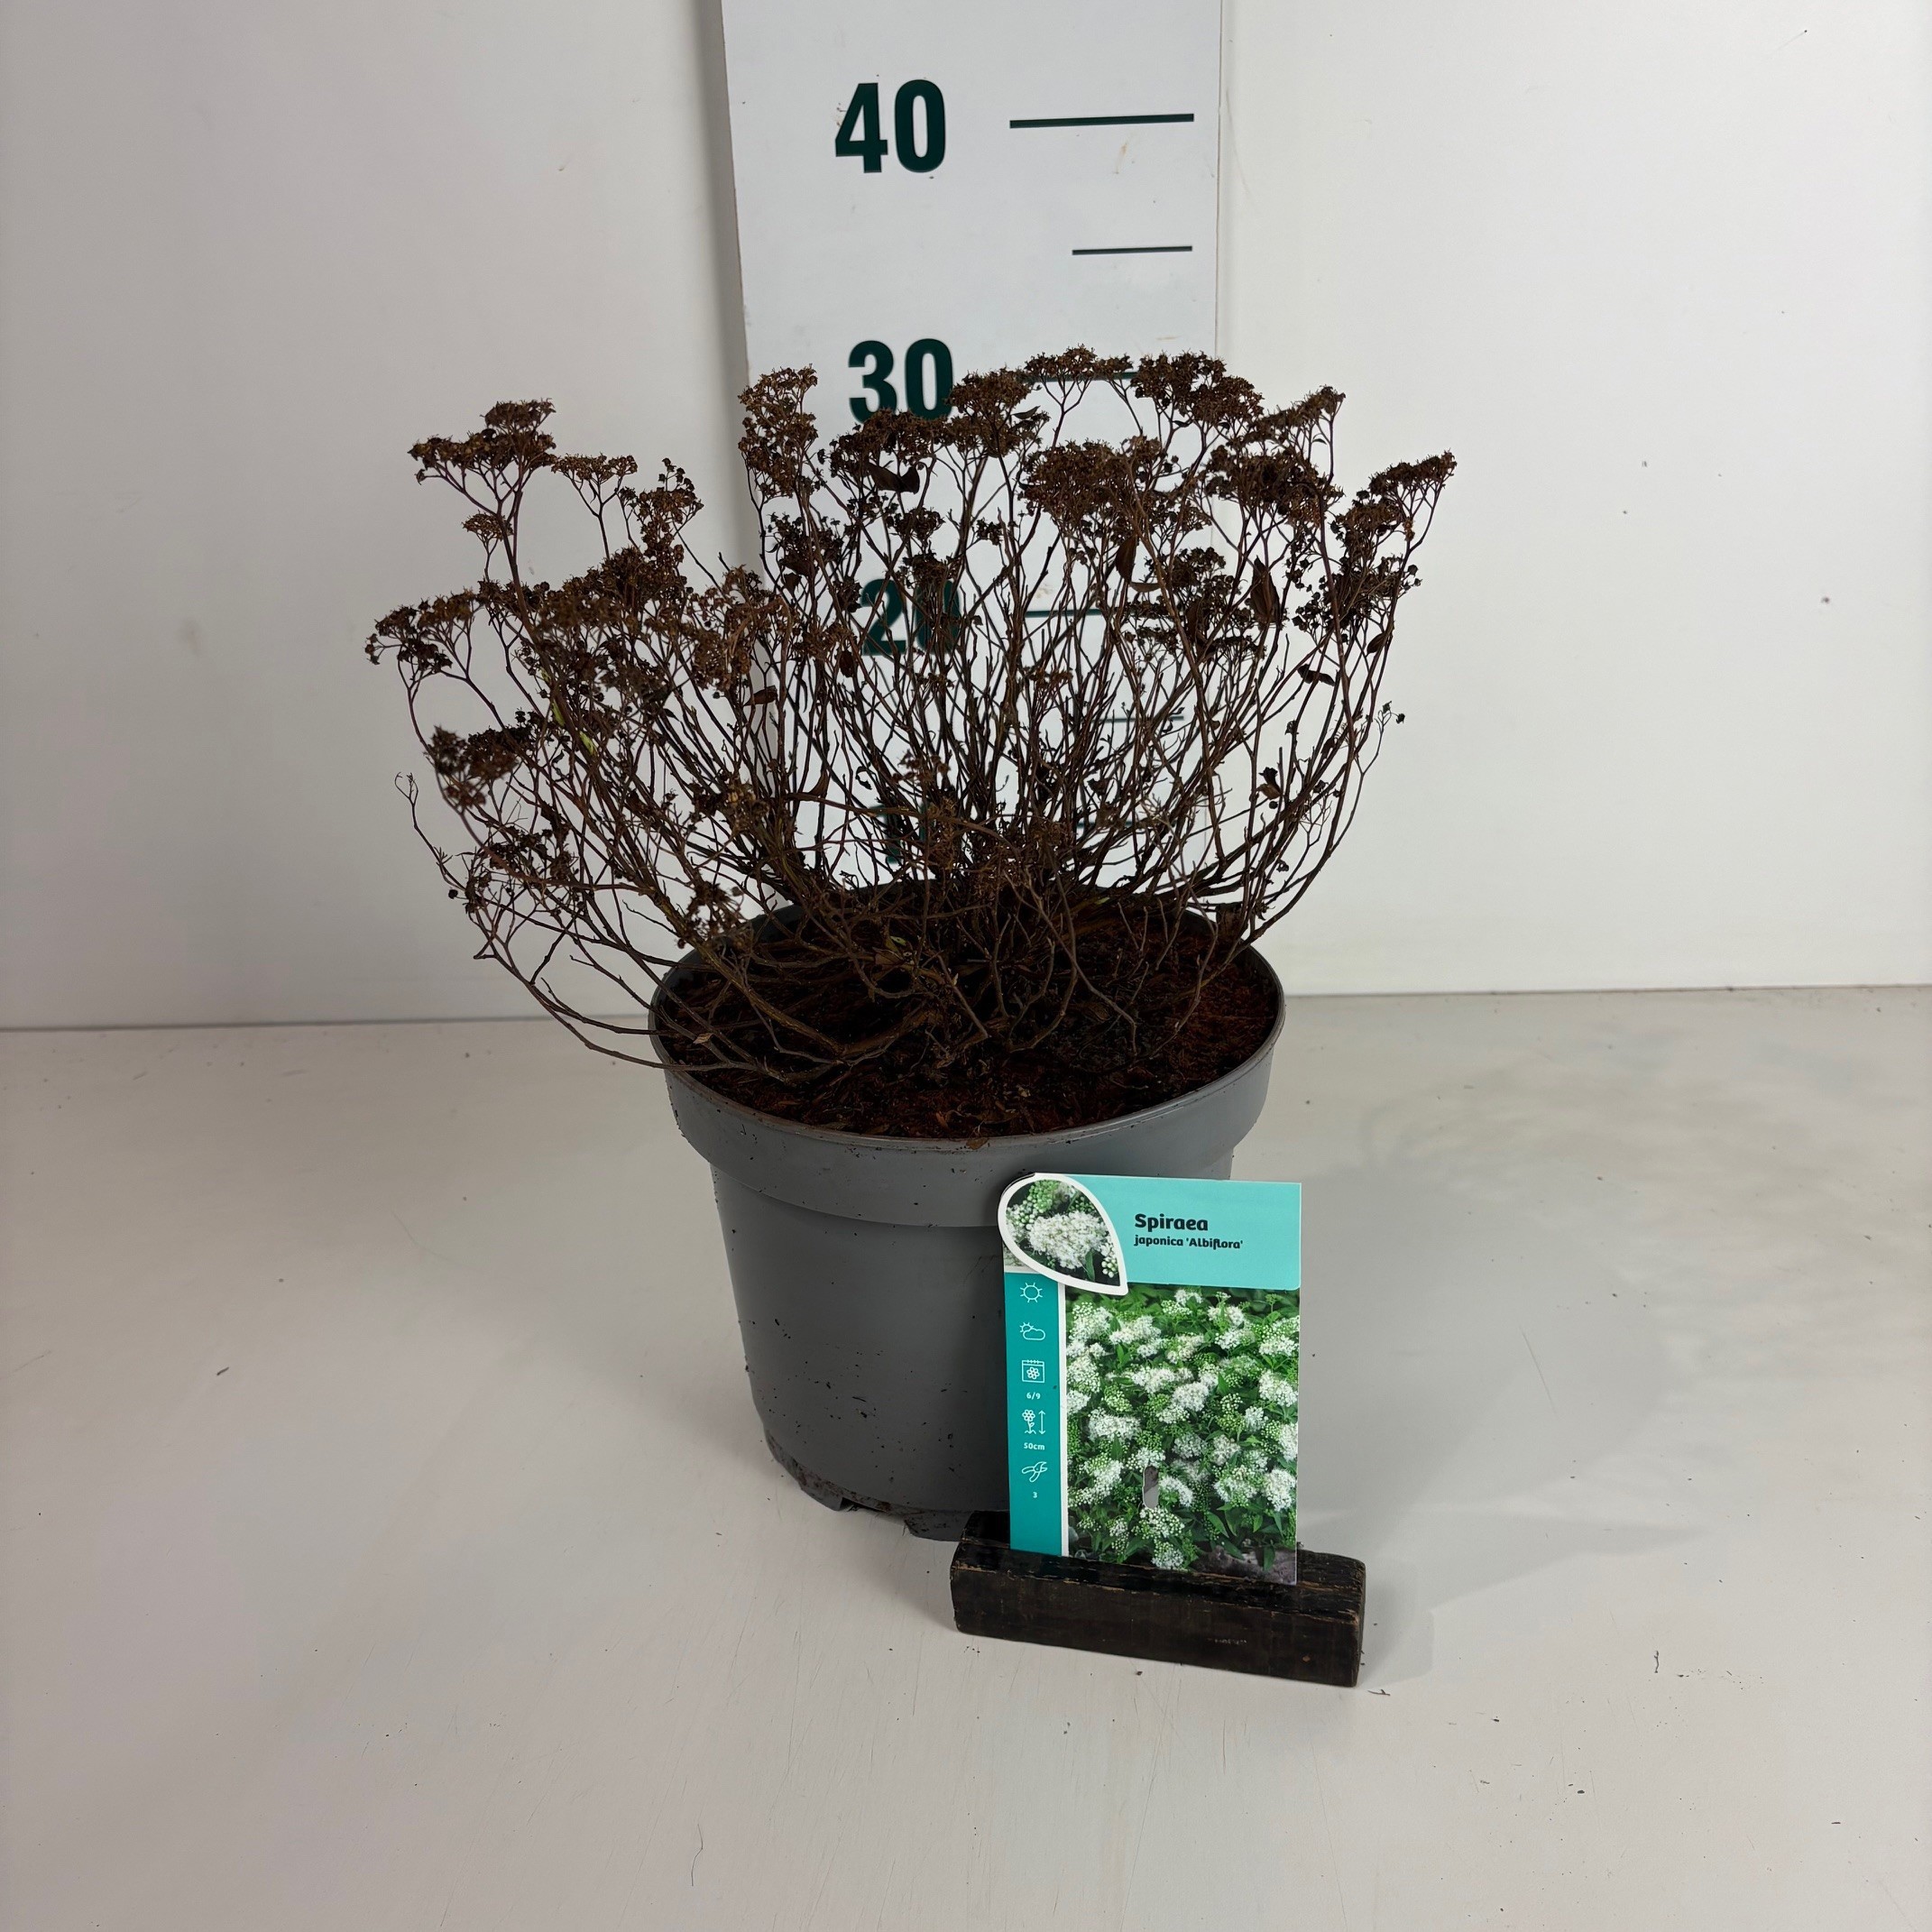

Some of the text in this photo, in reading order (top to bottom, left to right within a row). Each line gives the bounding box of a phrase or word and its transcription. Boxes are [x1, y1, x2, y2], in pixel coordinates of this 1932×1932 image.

[835, 79, 945, 173] 40
[848, 338, 953, 425] 30
[1134, 1213, 1209, 1232] Spiraea
[1134, 1235, 1243, 1250] japonica 'Albiflora'
[1026, 1392, 1041, 1400] 6/9
[1023, 1442, 1045, 1450] 50cm
